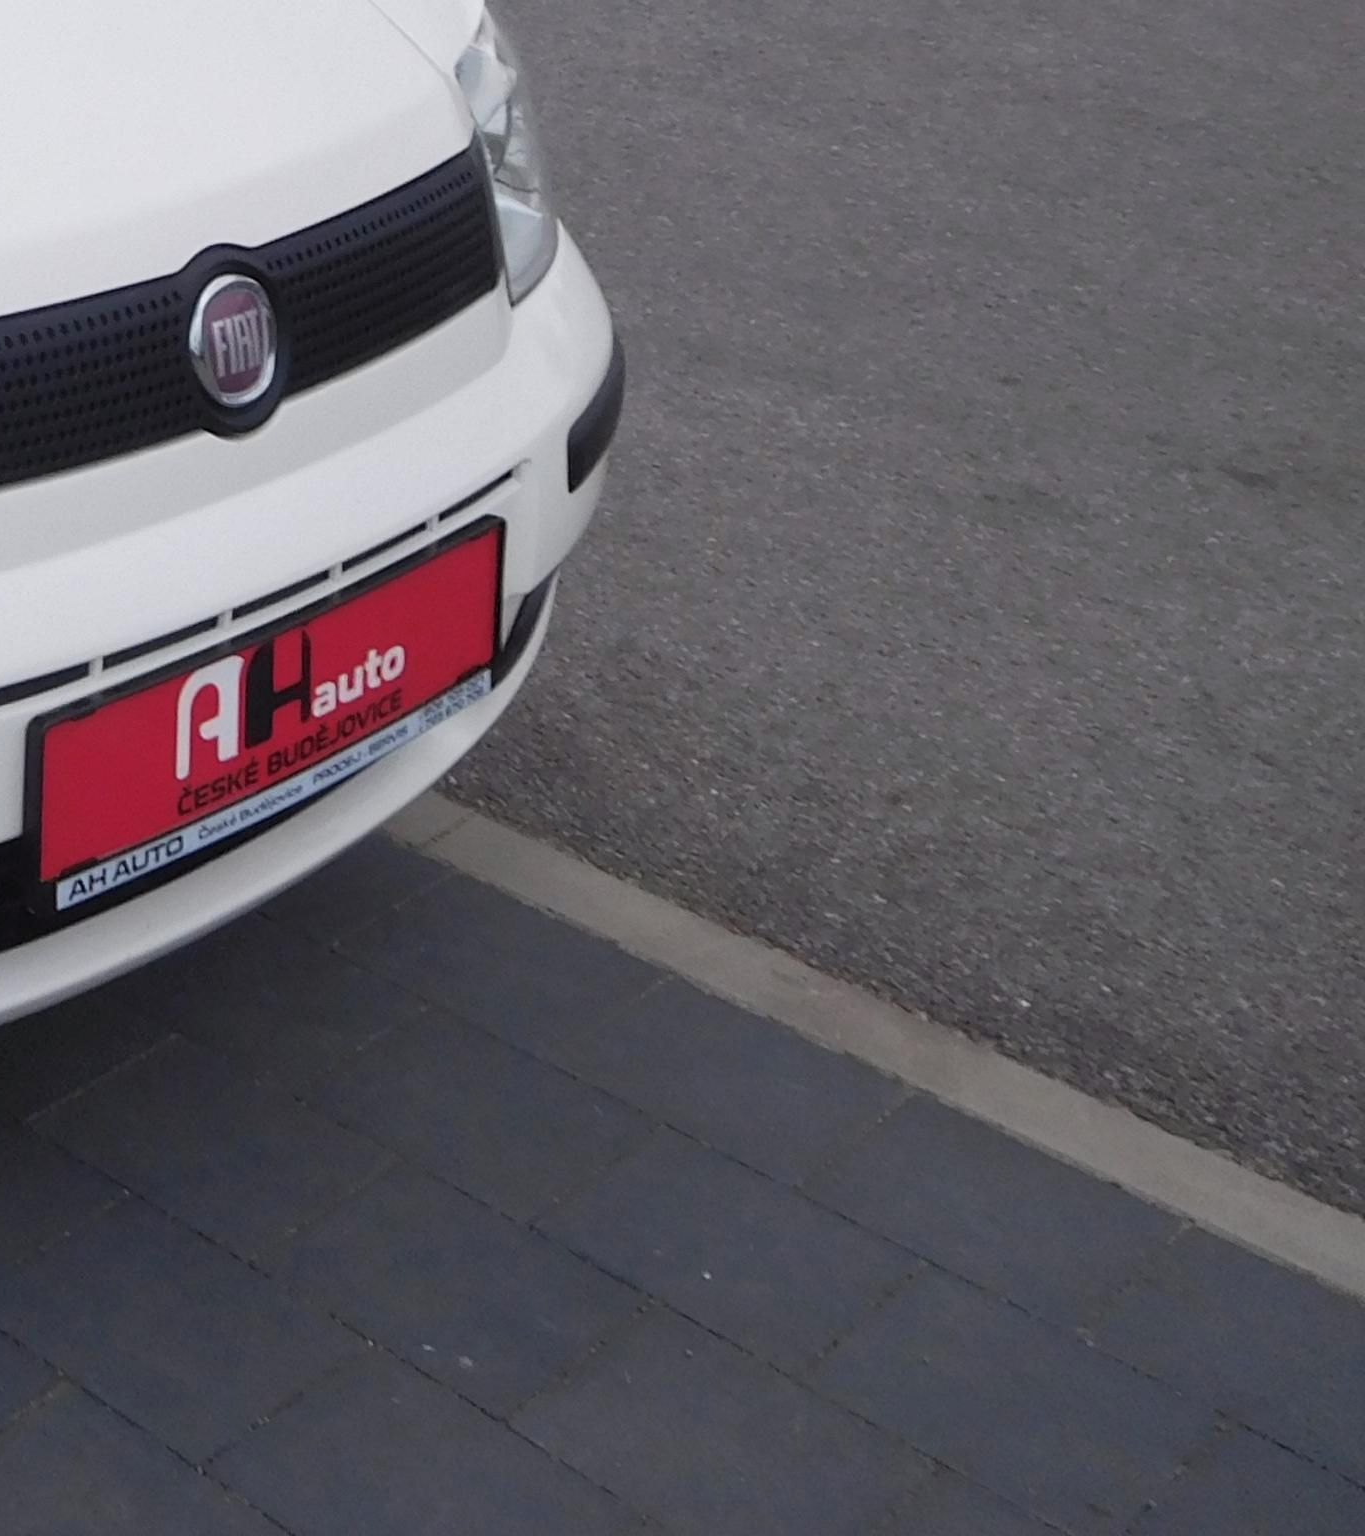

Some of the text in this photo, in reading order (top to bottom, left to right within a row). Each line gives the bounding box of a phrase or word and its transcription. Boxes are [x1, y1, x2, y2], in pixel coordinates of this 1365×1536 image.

[211, 309, 262, 379] FIAT
[177, 757, 260, 815] ČESKÉ
[266, 689, 403, 776] BUDĚJOVICE
[69, 868, 107, 901] AH
[112, 835, 185, 882] AUTO
